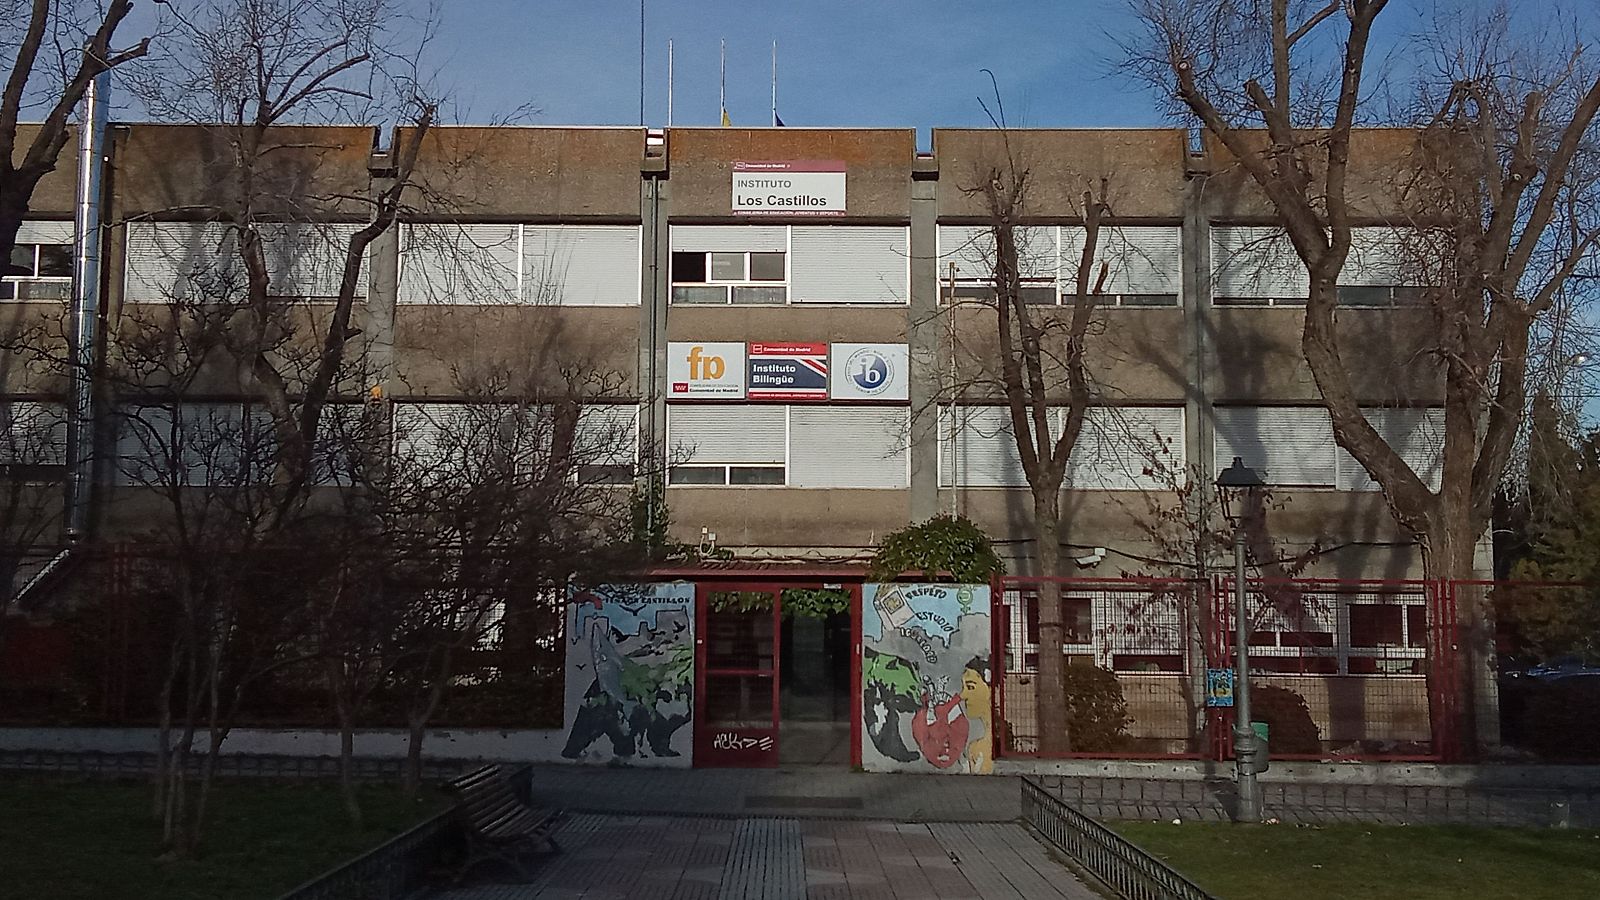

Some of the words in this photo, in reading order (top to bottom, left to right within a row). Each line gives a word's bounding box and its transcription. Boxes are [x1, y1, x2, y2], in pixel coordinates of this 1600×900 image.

[737, 180, 791, 188] INSTITUTO
[737, 195, 762, 206] Los
[767, 195, 827, 206] Castillos
[687, 347, 725, 380] fp
[753, 364, 796, 373] Instituto
[753, 375, 794, 385] Bilingüe
[905, 587, 947, 600] RESPETO
[915, 611, 954, 632] ESTUDIO
